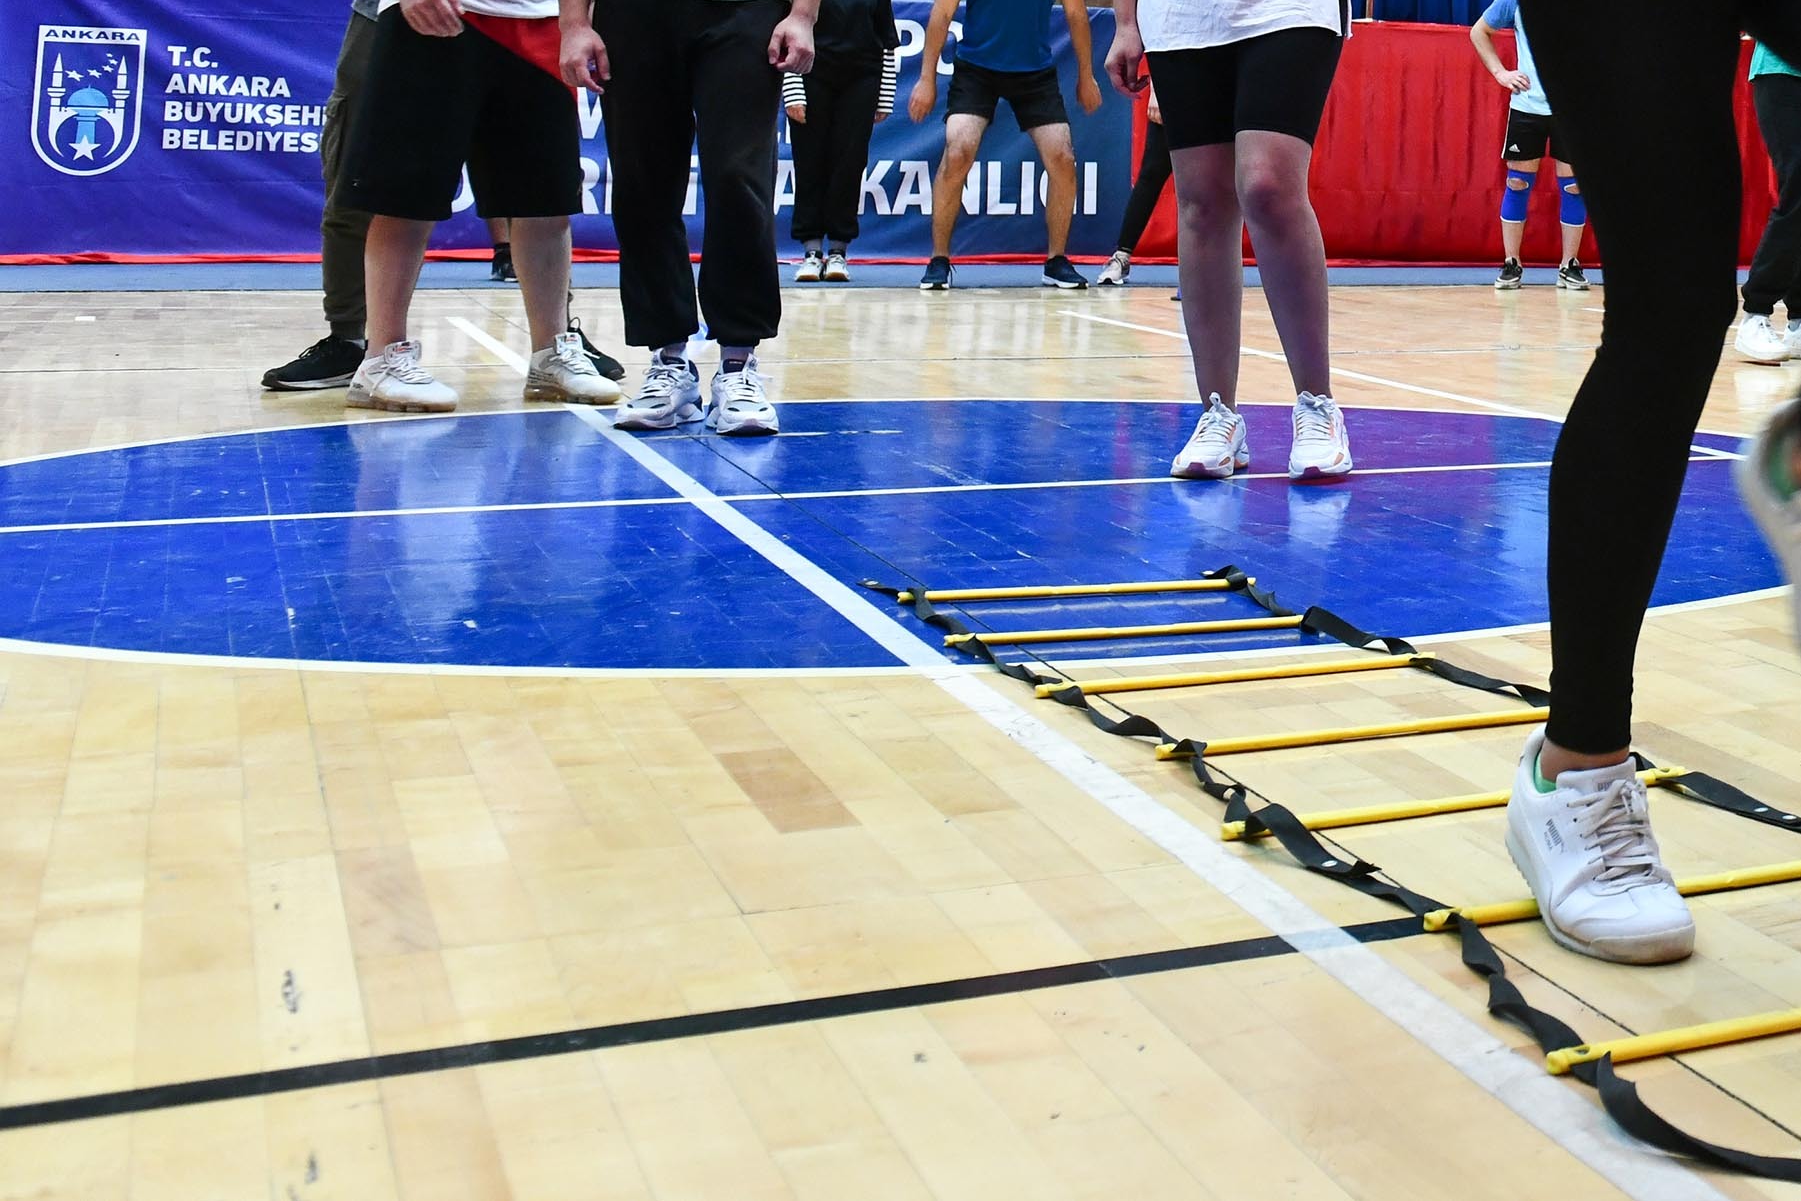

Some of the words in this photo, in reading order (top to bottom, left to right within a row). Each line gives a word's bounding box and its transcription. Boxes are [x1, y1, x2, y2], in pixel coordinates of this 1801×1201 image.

[44, 28, 141, 42] ANKARA
[166, 45, 219, 69] T.C.
[165, 72, 292, 98] ANKARA
[161, 128, 322, 154] BELEDİYES
